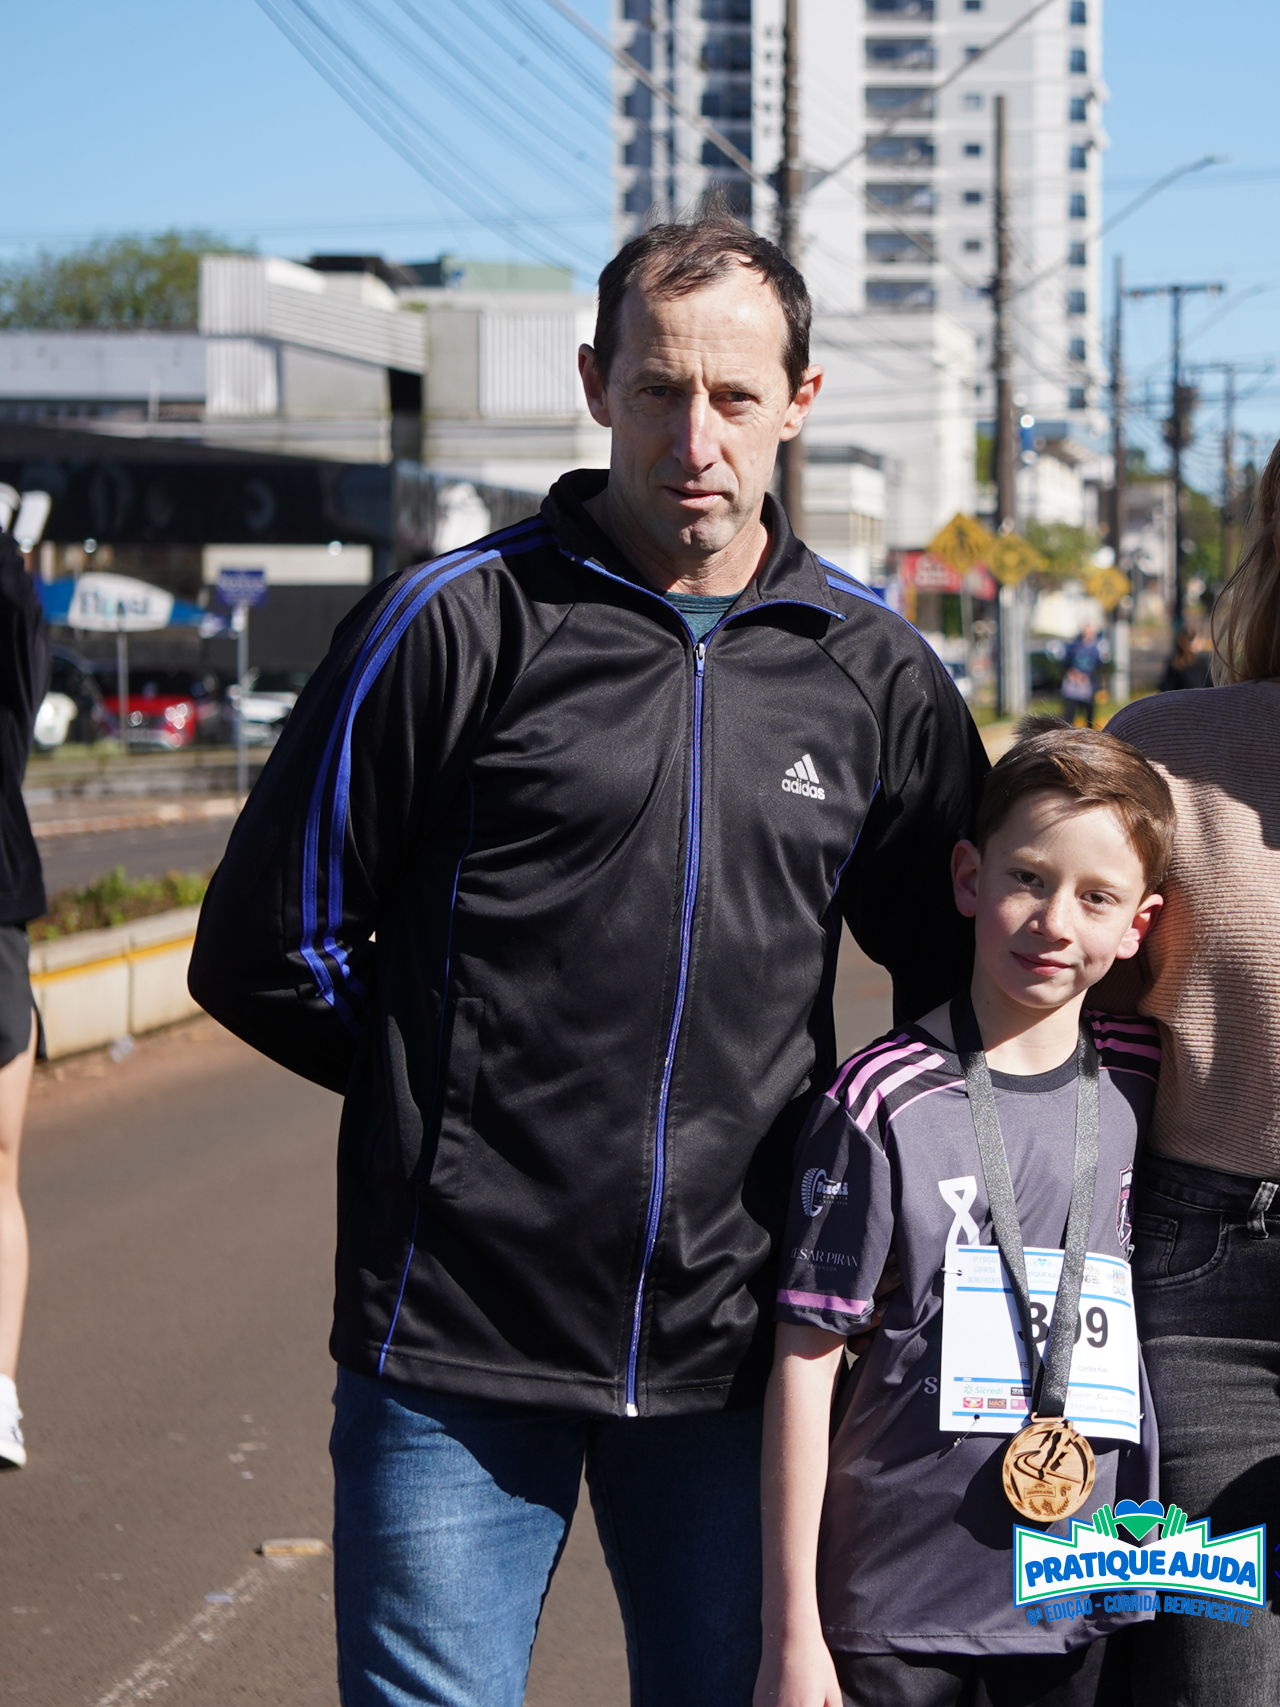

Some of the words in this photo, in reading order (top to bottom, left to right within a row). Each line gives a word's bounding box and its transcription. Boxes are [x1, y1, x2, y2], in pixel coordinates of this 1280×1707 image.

[781, 778, 826, 800] adidas
[1077, 1364, 1097, 1373] Corrida
[1097, 1366, 1108, 1374] Kids
[975, 1386, 1003, 1395] Sicredi
